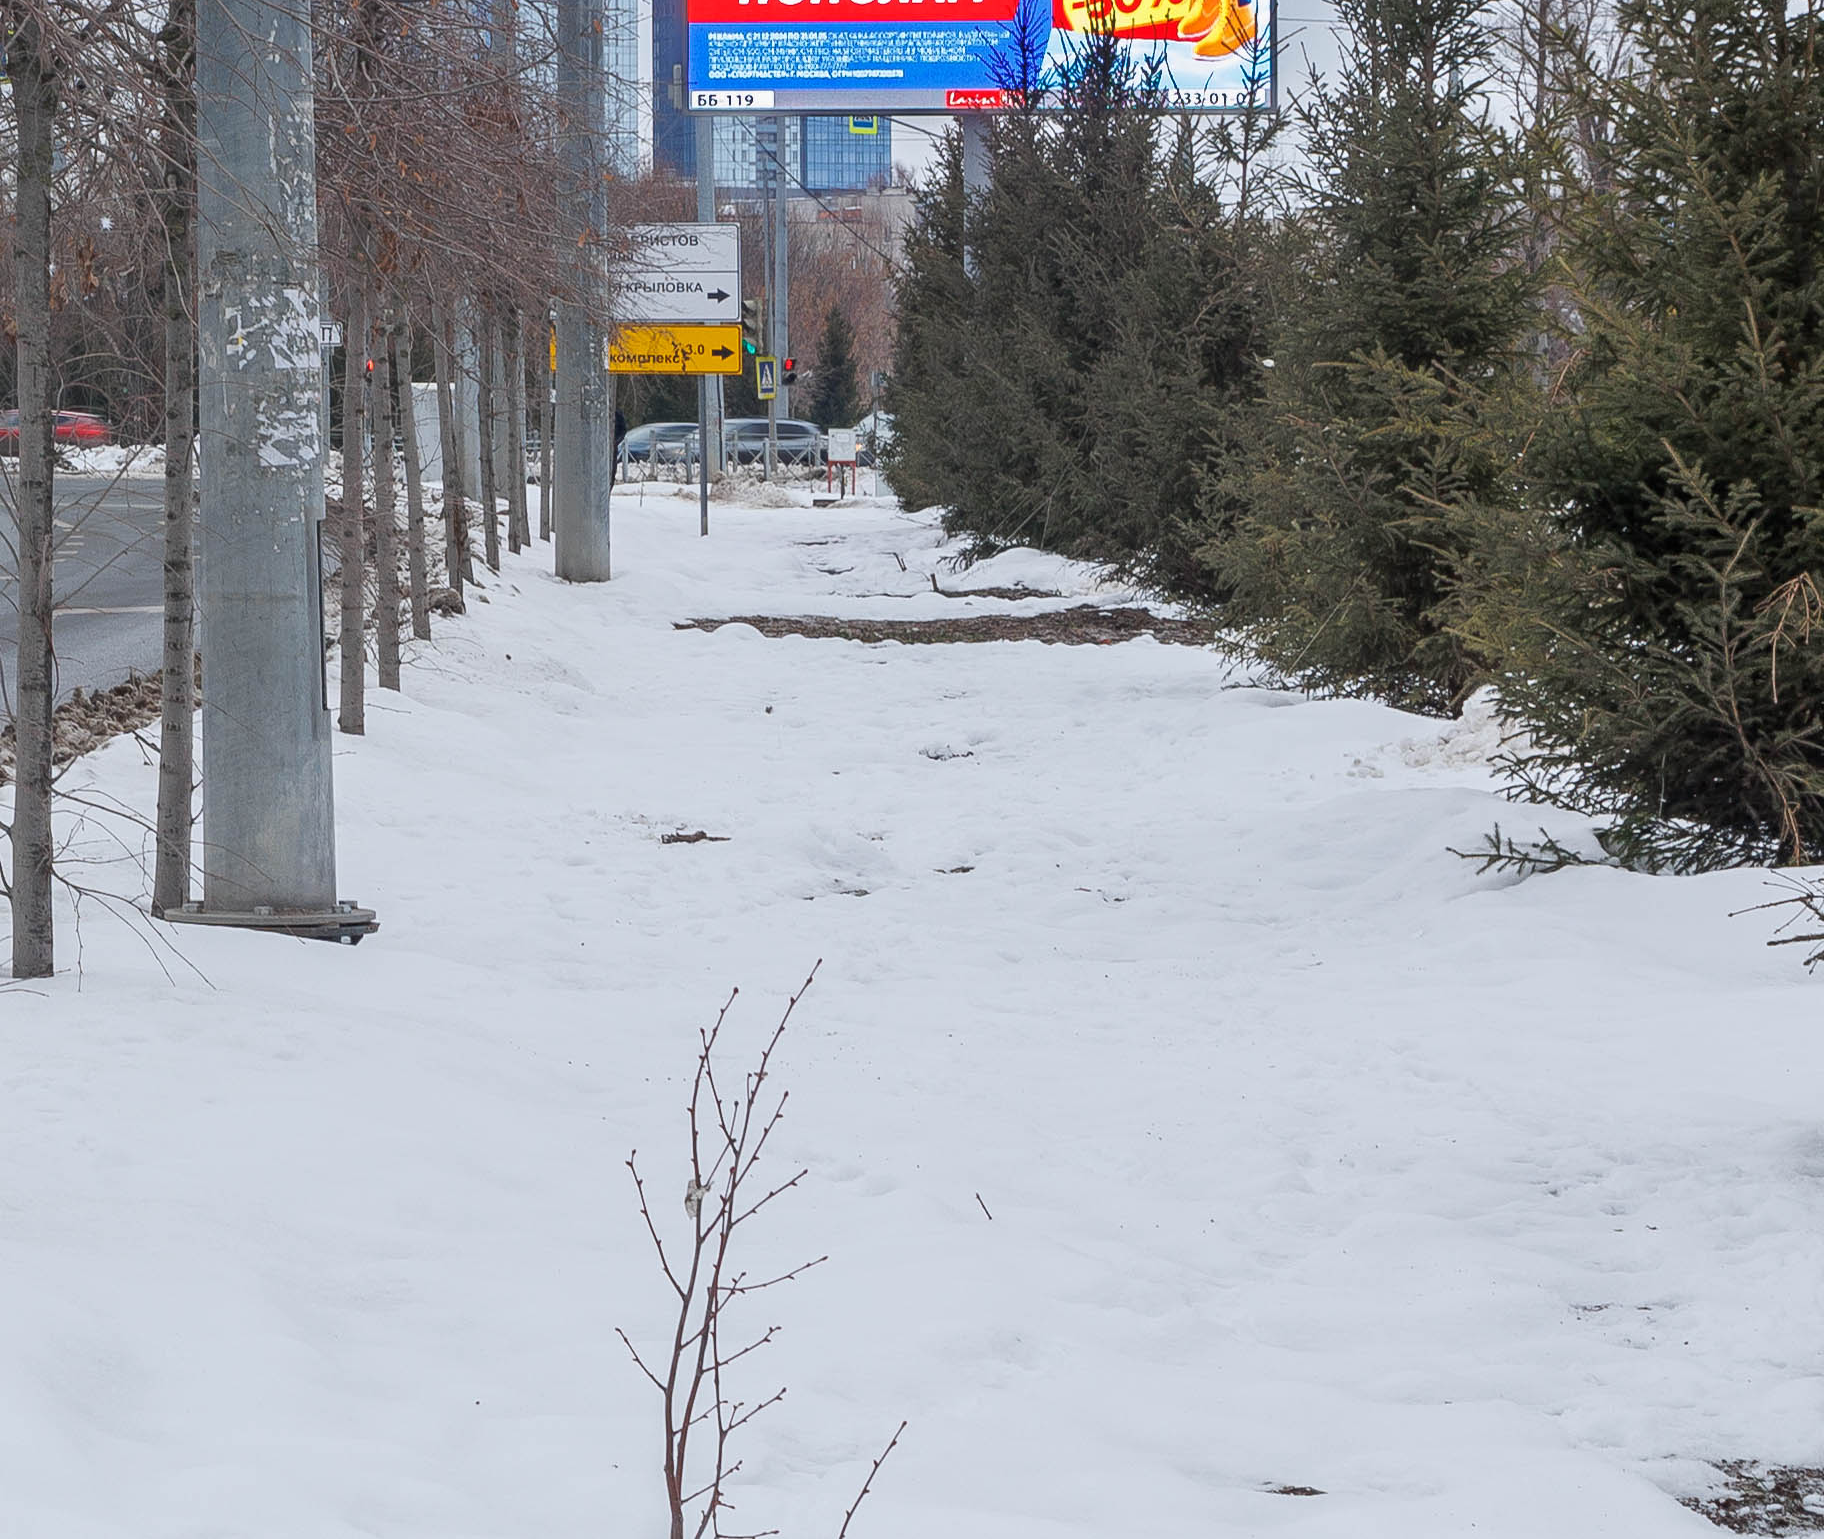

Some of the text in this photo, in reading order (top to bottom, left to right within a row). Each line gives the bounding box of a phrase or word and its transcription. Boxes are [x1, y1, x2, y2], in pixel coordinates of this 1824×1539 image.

[726, 94, 754, 107] 119
[626, 282, 704, 293] КРЫЛОВКА
[685, 344, 705, 355] 3.0
[609, 352, 681, 364] комплекс
